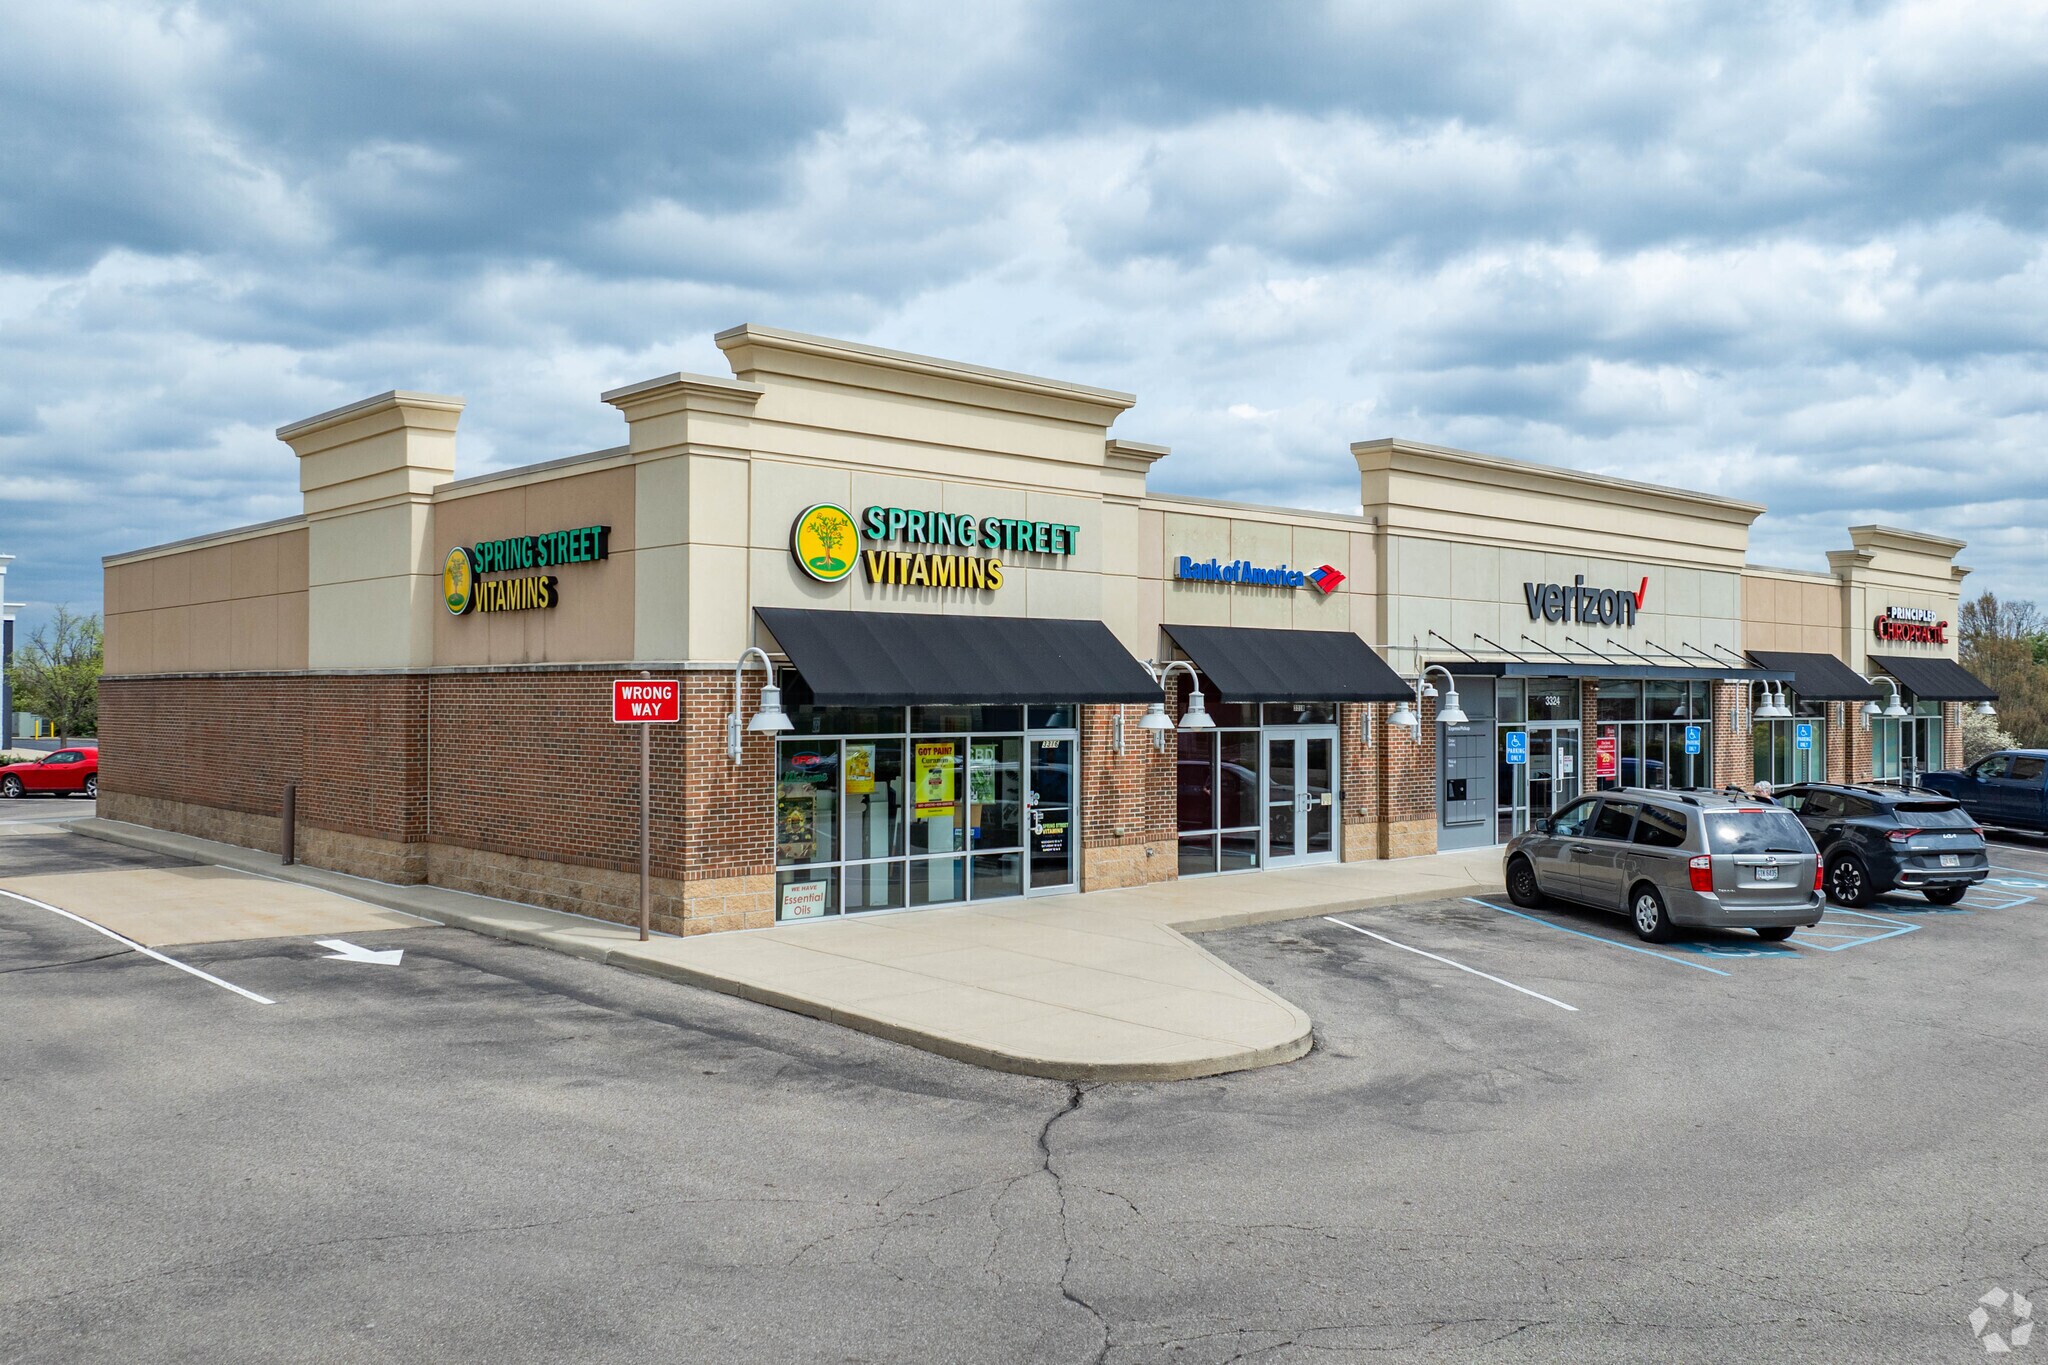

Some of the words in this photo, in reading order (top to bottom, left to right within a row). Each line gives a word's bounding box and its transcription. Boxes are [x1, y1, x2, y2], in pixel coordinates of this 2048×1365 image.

[866, 505, 977, 548] SPRING
[981, 517, 1081, 556] STREET
[474, 535, 532, 574] SPRING
[536, 525, 603, 567] STREET
[865, 549, 1005, 591] VITAMINS
[1178, 555, 1222, 582] Bank
[1222, 560, 1241, 583] of
[1241, 561, 1305, 587] America
[474, 575, 550, 613] VITAMINS
[1523, 574, 1636, 625] verizon
[1891, 606, 1937, 622] PRINCIPLED
[621, 686, 672, 700] WRONG
[1545, 696, 1560, 706] 3324
[631, 702, 662, 716] WAY
[918, 747, 932, 756] GOT
[933, 746, 953, 755] PAIN?
[783, 892, 824, 906] Essential
[793, 905, 812, 916] Oils
